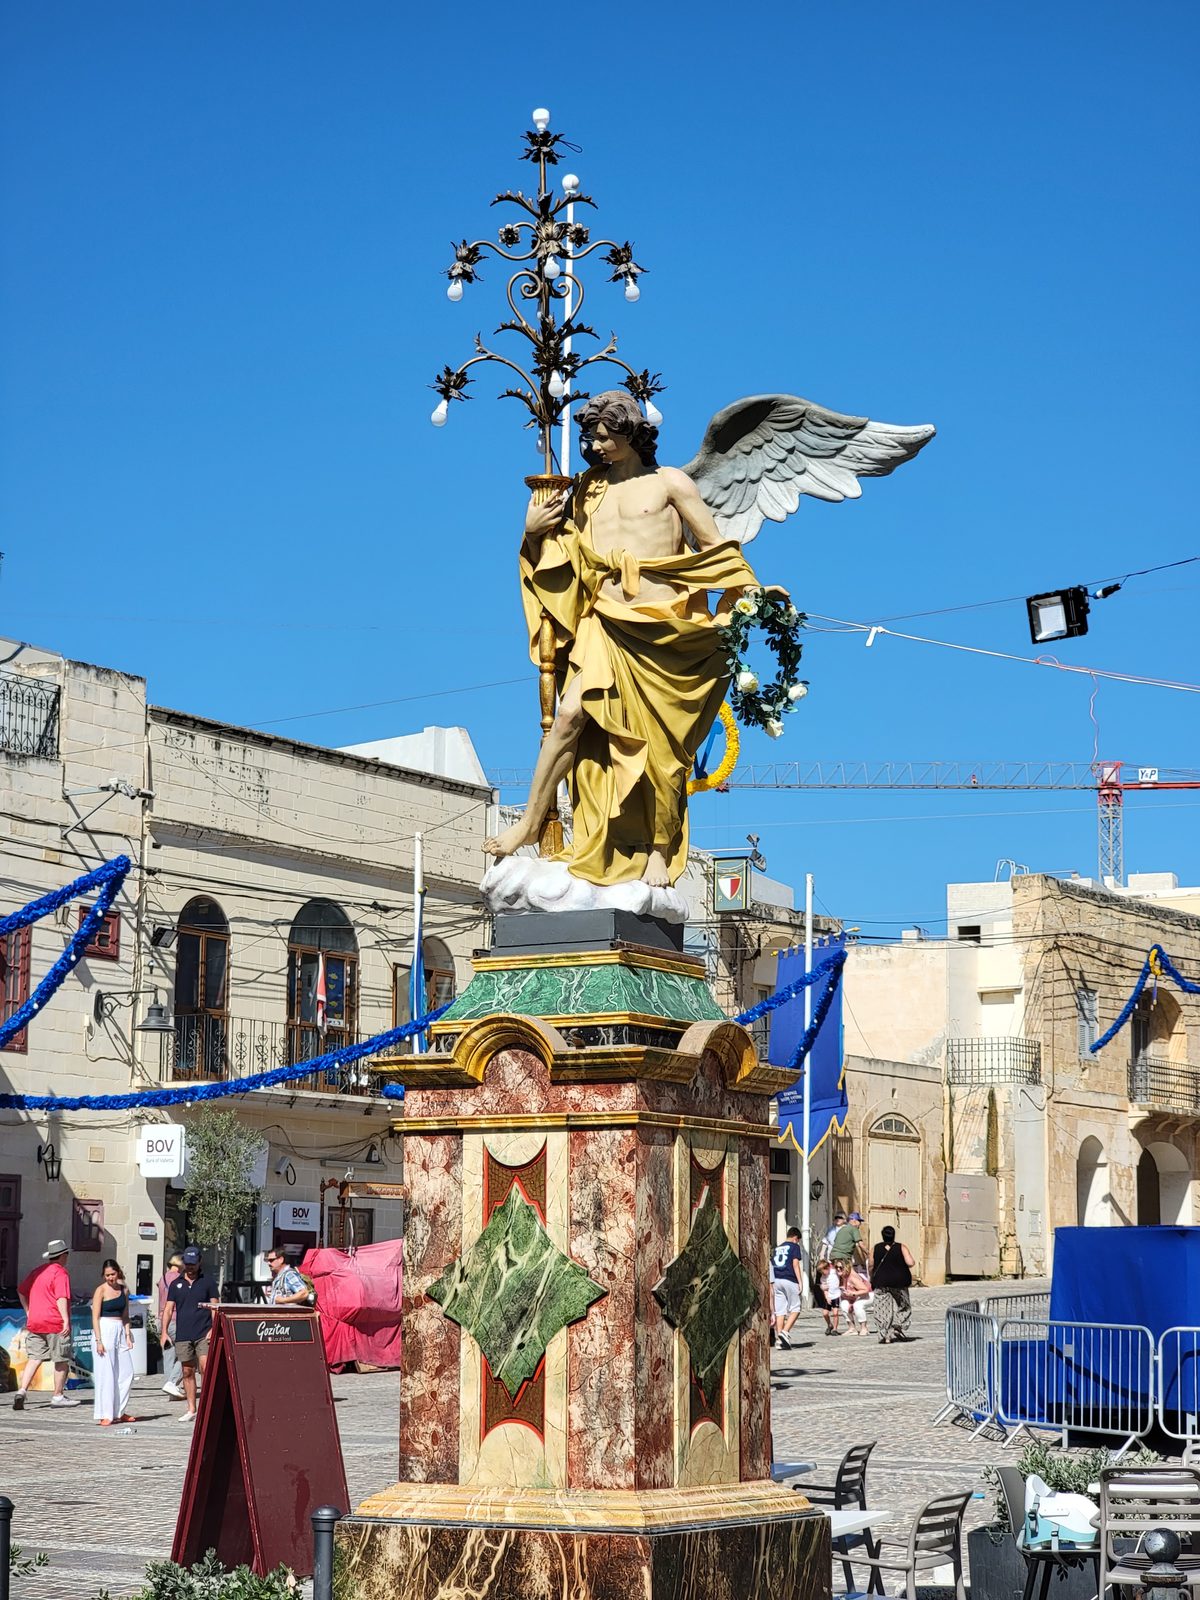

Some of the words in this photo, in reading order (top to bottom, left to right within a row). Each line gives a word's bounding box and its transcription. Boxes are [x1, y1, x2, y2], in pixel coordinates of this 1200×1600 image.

[146, 1139, 174, 1153] BOV
[292, 1207, 310, 1218] BOV
[256, 1321, 291, 1341] Gozitan
